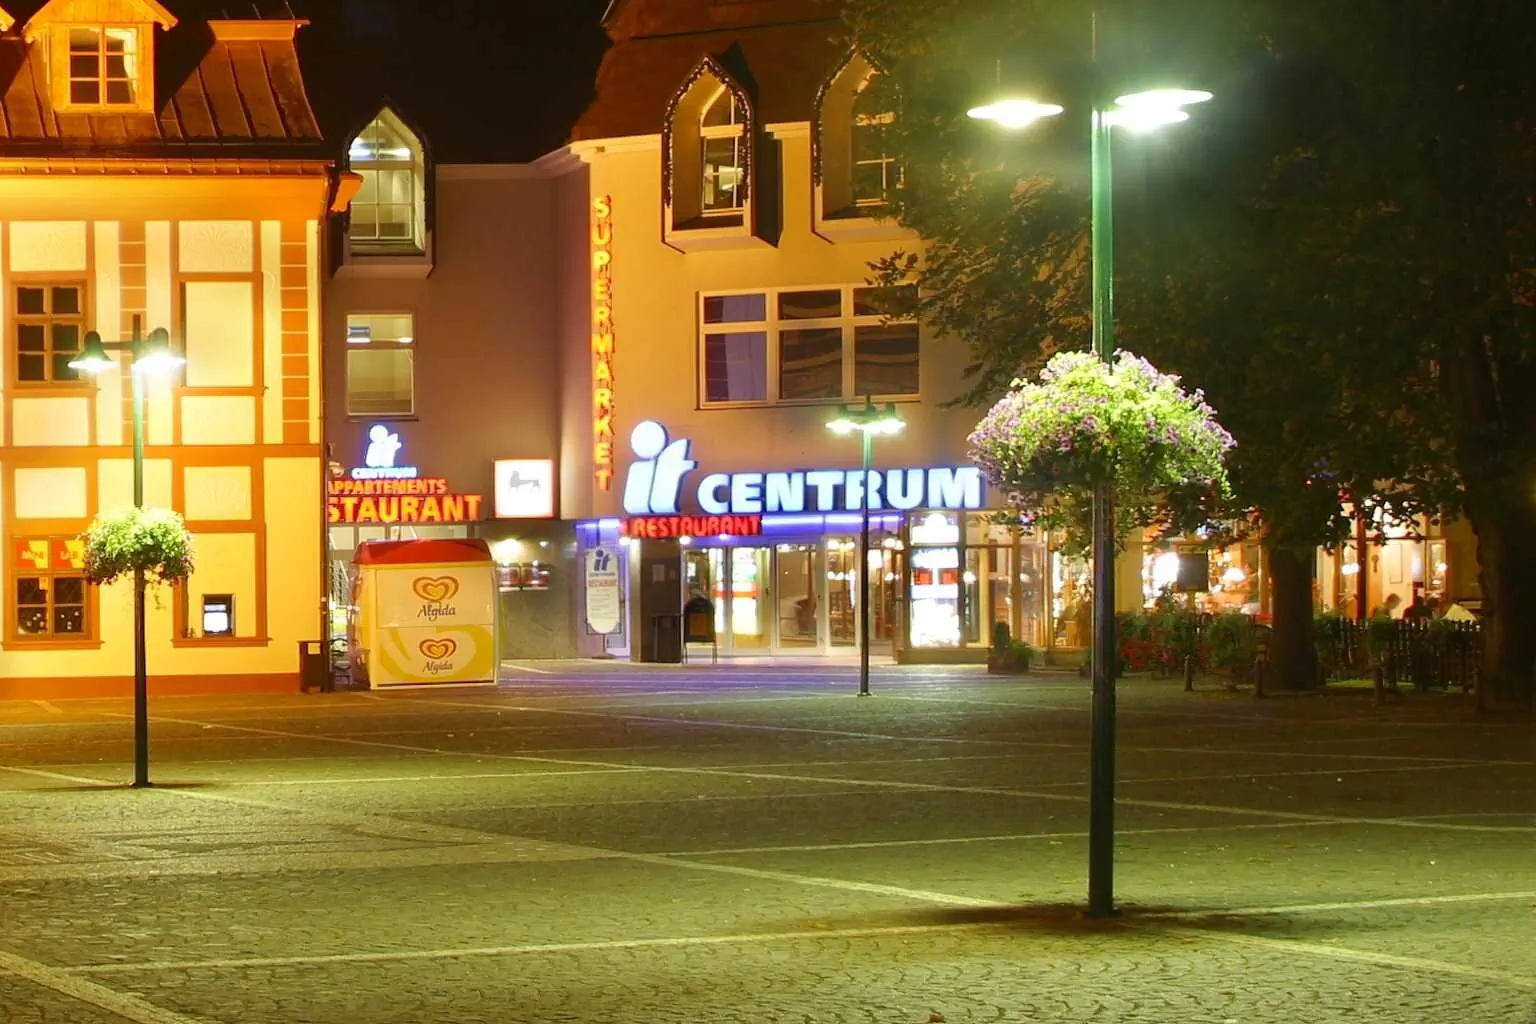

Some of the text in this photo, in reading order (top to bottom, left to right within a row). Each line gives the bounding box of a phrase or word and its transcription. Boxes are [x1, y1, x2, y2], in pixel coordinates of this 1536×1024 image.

[592, 195, 614, 491] SUPERMARKET
[697, 466, 983, 515] CENTRUM
[633, 516, 761, 538] RESTAURANT
[417, 603, 456, 622] Algida
[422, 661, 453, 675] Algida
